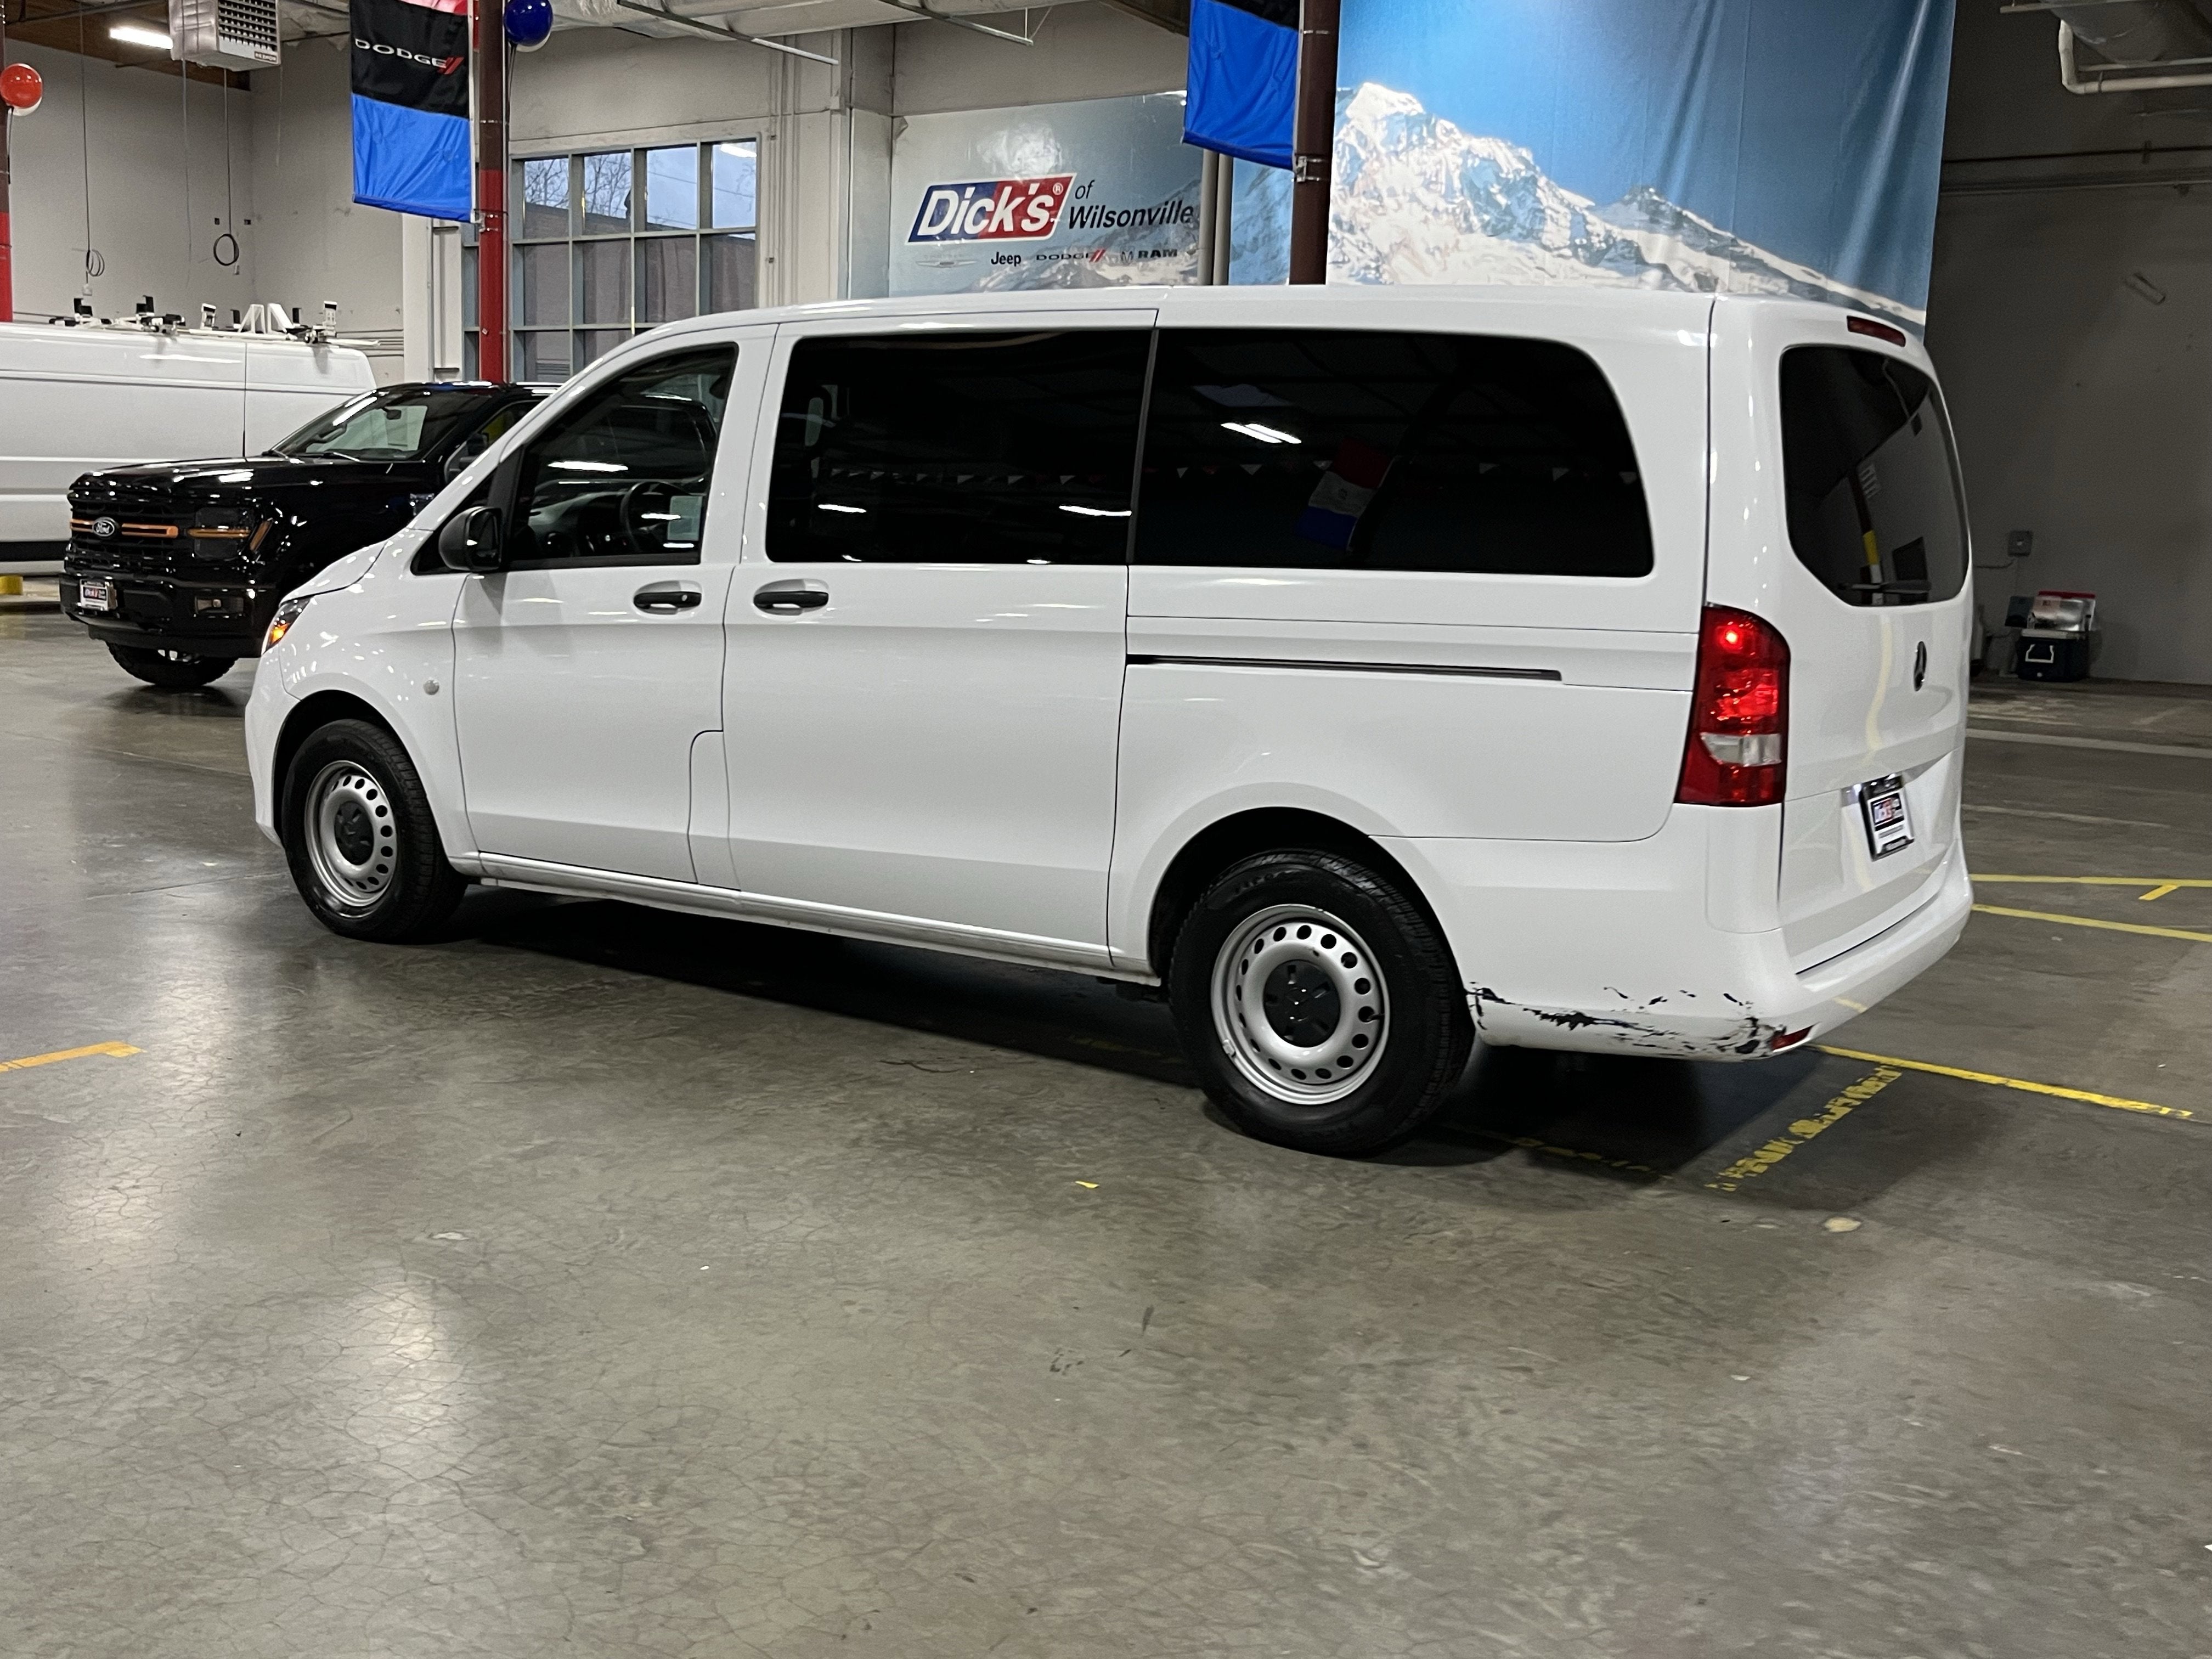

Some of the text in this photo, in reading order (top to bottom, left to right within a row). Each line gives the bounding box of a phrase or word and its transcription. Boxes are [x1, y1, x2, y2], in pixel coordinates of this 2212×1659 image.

[355, 38, 447, 69] DODGE
[1075, 179, 1095, 199] of
[1069, 200, 1194, 229] Wilsonville
[991, 251, 1021, 267] Jeep
[1138, 249, 1177, 258] RAM
